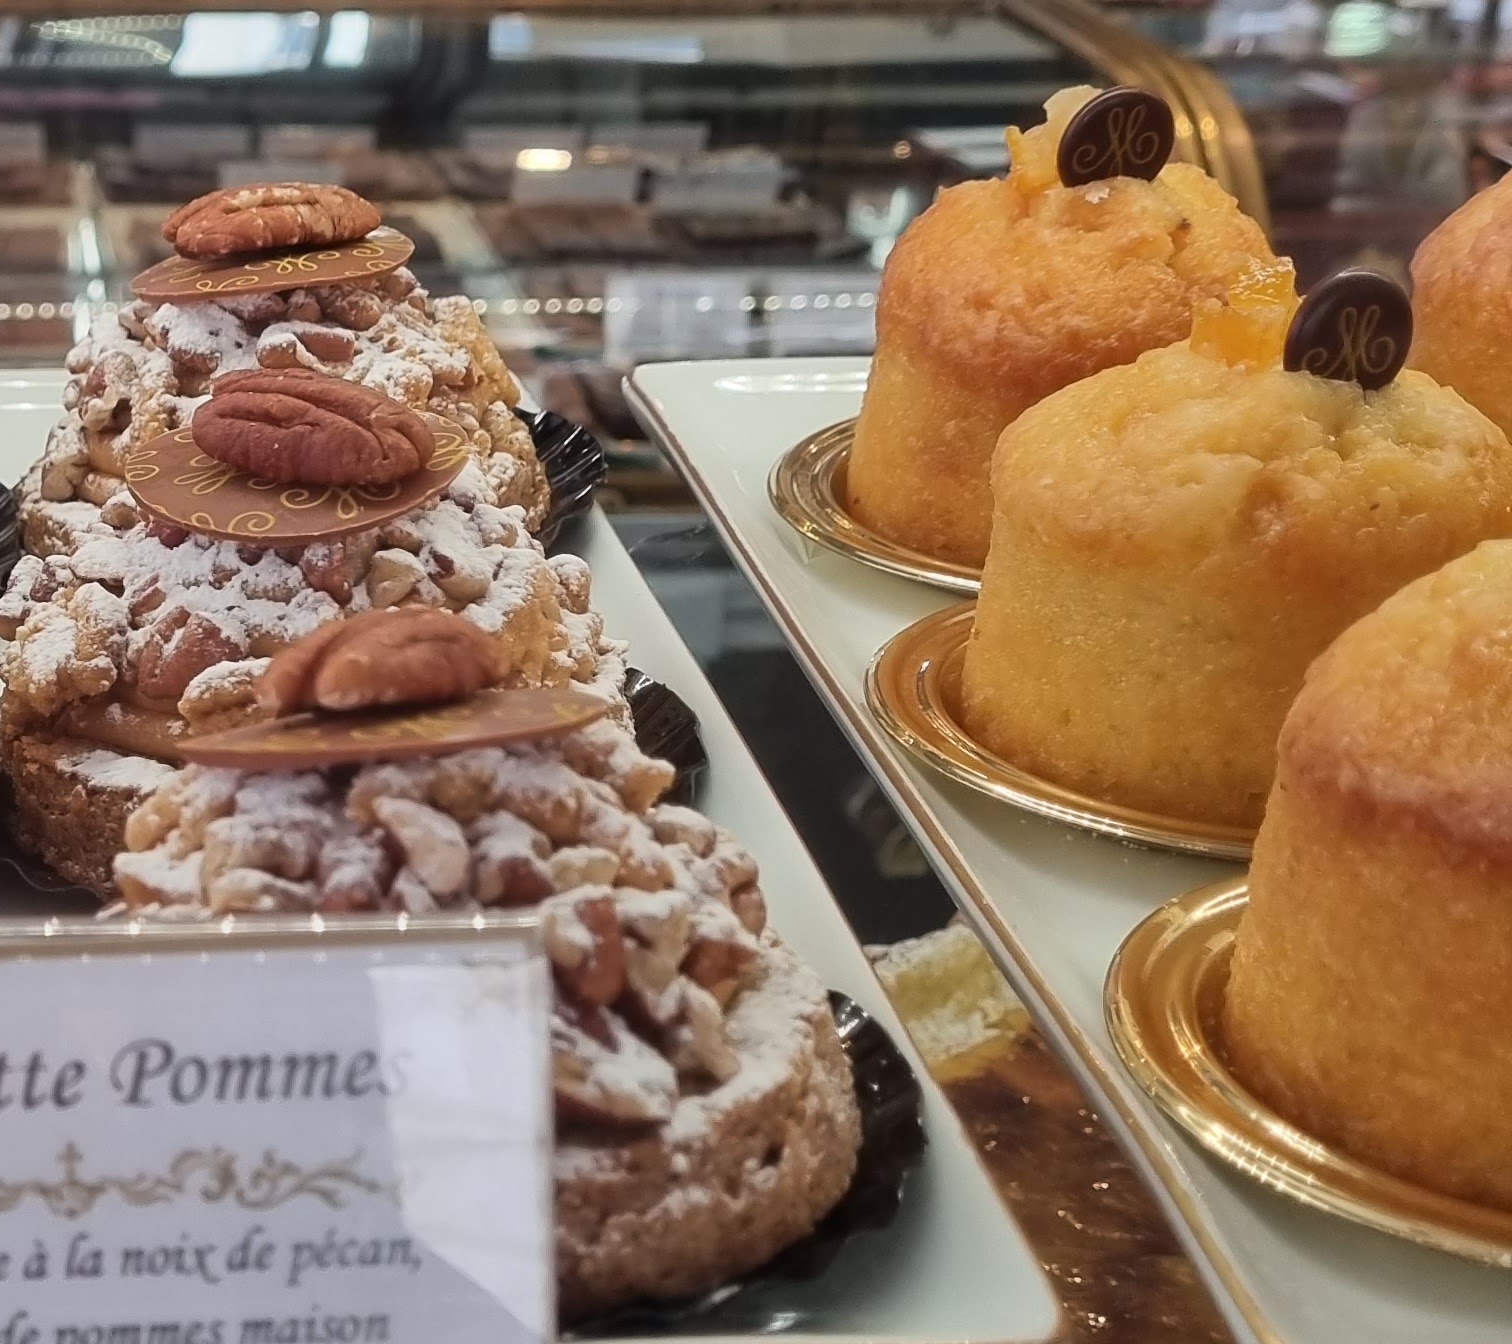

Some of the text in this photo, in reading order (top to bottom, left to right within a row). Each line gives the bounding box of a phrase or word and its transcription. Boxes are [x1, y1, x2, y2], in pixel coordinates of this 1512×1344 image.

[111, 1039, 410, 1107] Pommes
[22, 1240, 49, 1281] à
[64, 1232, 104, 1279] la
[121, 1239, 219, 1284] noix
[225, 1225, 275, 1273] de
[288, 1234, 422, 1286] pécan,
